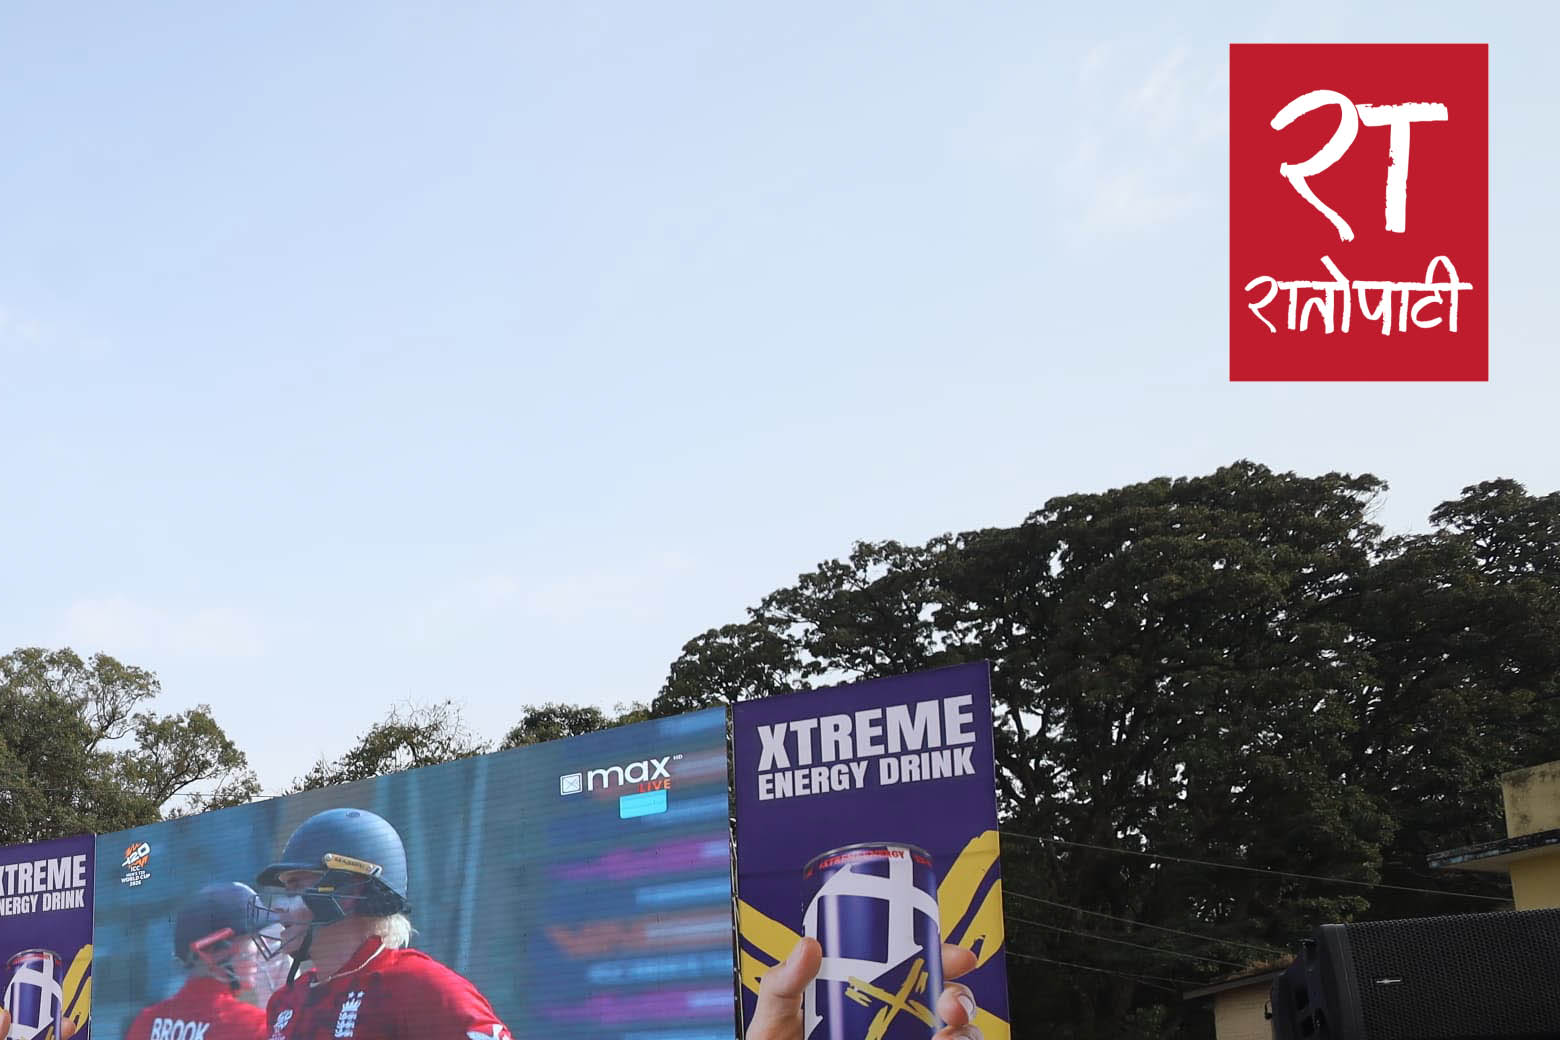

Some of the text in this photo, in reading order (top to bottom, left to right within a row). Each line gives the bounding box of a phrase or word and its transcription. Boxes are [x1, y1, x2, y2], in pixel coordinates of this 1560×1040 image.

[757, 694, 976, 771] XTREME
[587, 756, 671, 791] max
[637, 778, 672, 793] LIVE
[758, 746, 976, 801] ENERGY DRINK
[42, 889, 85, 911] DRINK
